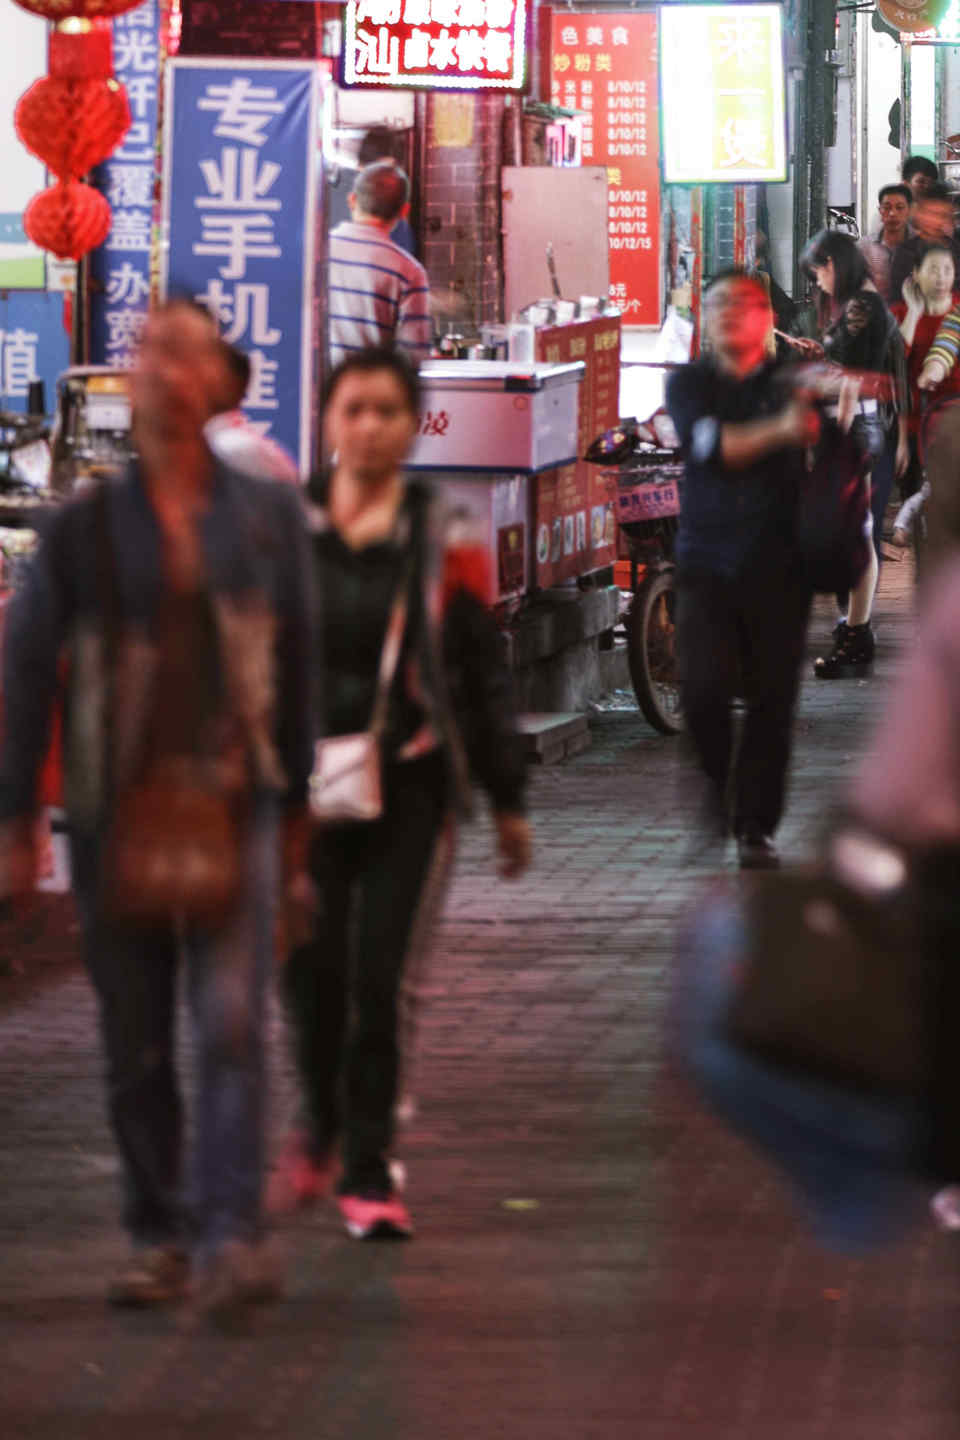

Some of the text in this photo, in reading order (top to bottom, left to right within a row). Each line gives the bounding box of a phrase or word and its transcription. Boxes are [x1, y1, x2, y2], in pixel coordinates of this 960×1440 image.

[607, 79, 647, 94] 8/10/12
[607, 95, 647, 110] 8/10/12
[607, 111, 647, 125] 8/10/12
[607, 127, 647, 141] 8/10/12
[607, 143, 647, 157] 8/10/12
[608, 190, 648, 203] 8/10/12
[608, 206, 648, 219] 8/10/12
[608, 222, 648, 234] 8/10/12
[608, 237, 652, 250] 10/12/15
[192, 76, 286, 436] 专业手机
